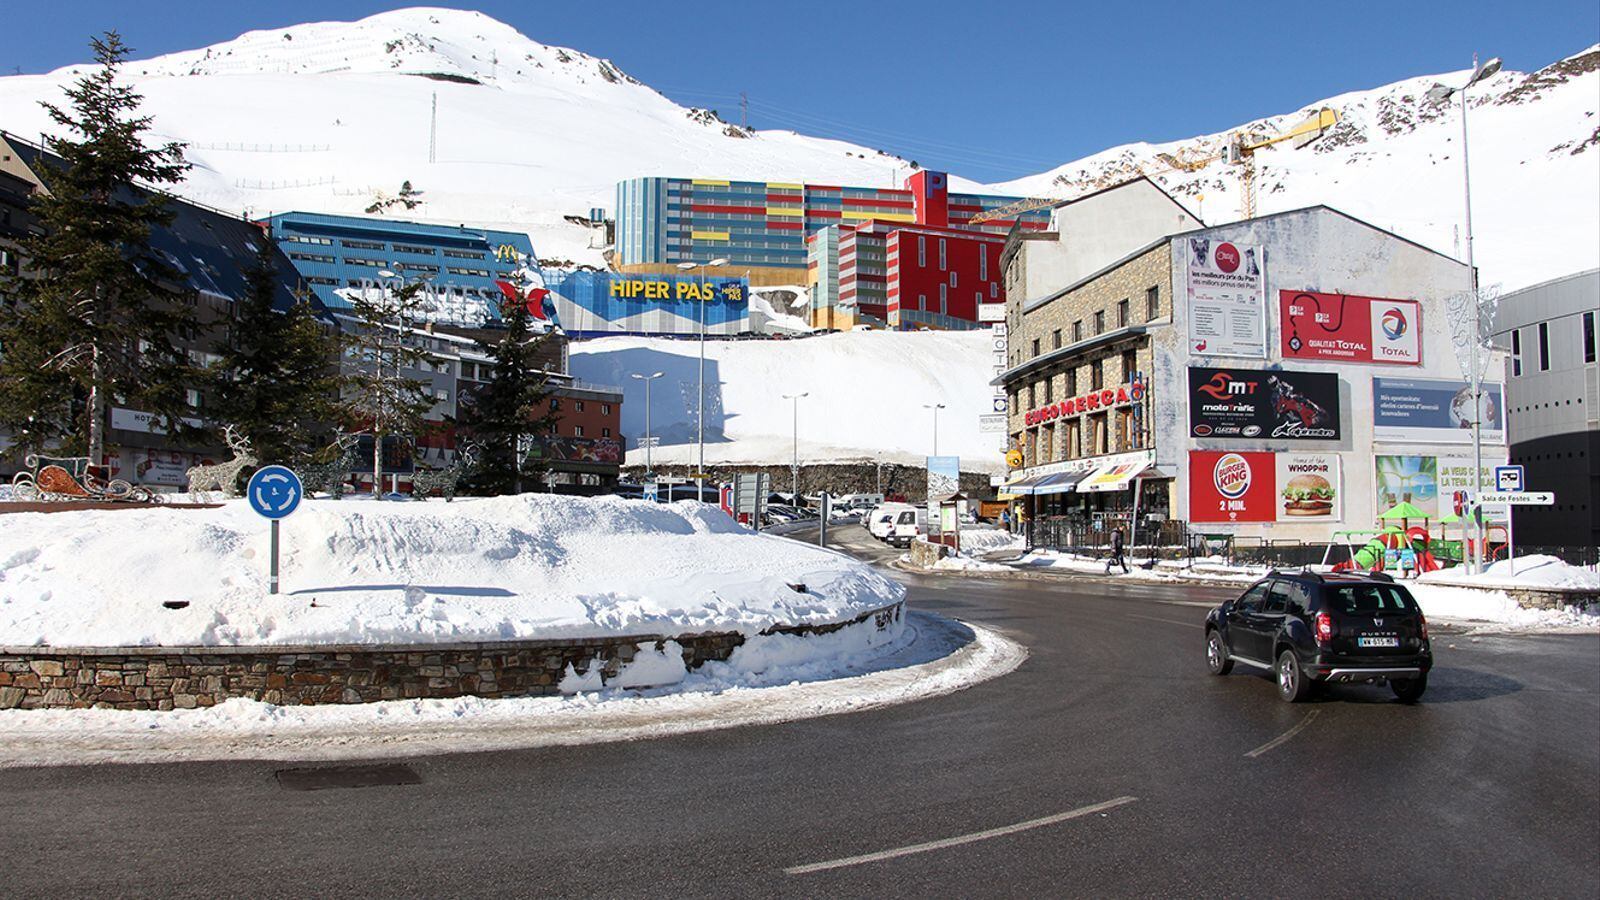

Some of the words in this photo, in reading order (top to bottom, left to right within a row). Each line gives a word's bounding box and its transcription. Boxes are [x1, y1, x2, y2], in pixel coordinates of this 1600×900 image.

[609, 279, 671, 300] HIPER
[675, 281, 715, 301] PAS
[721, 287, 742, 296] HIPER
[1336, 340, 1367, 351] TOTAL
[1380, 346, 1411, 357] TOTAL
[1218, 462, 1246, 479] BURGER
[1219, 470, 1247, 487] KING
[1441, 478, 1450, 487] LA
[1219, 500, 1226, 511] 2
[1227, 500, 1246, 511] MIN.
